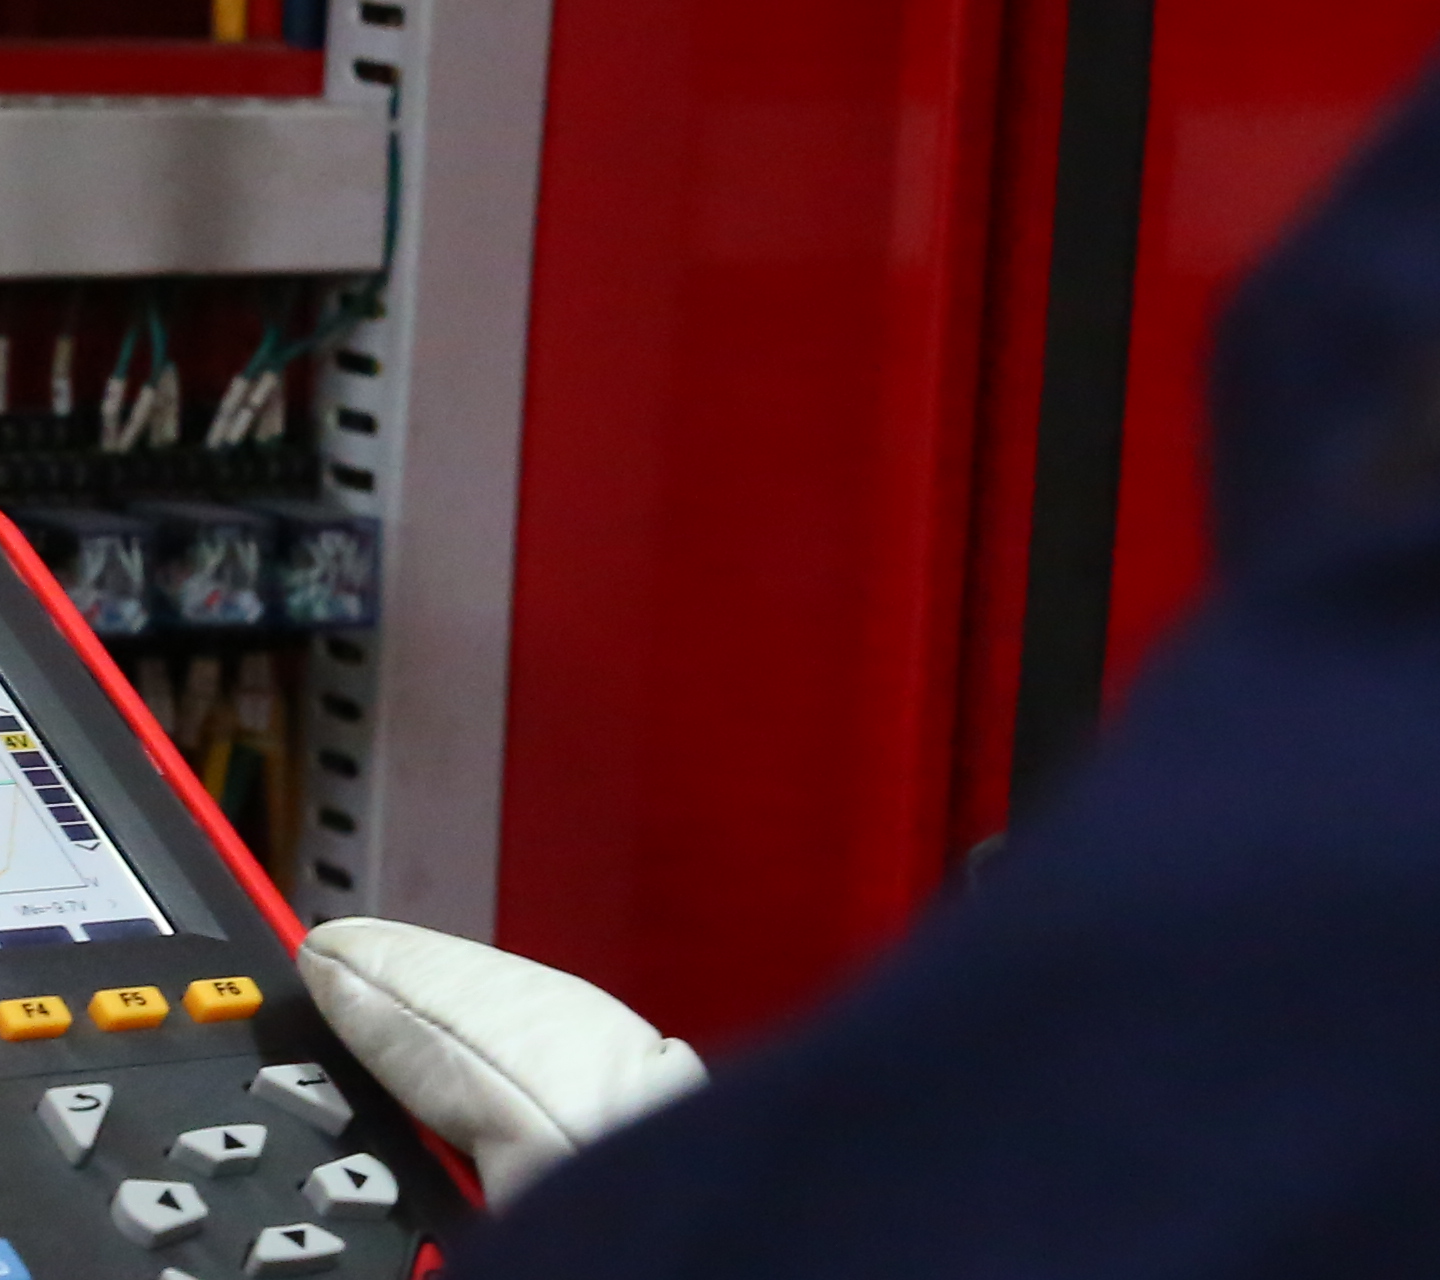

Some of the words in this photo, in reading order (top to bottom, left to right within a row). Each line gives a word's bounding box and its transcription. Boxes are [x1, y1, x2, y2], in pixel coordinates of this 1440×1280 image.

[21, 1002, 51, 1019] F4
[118, 991, 148, 1008] F5
[213, 981, 242, 997] F6
